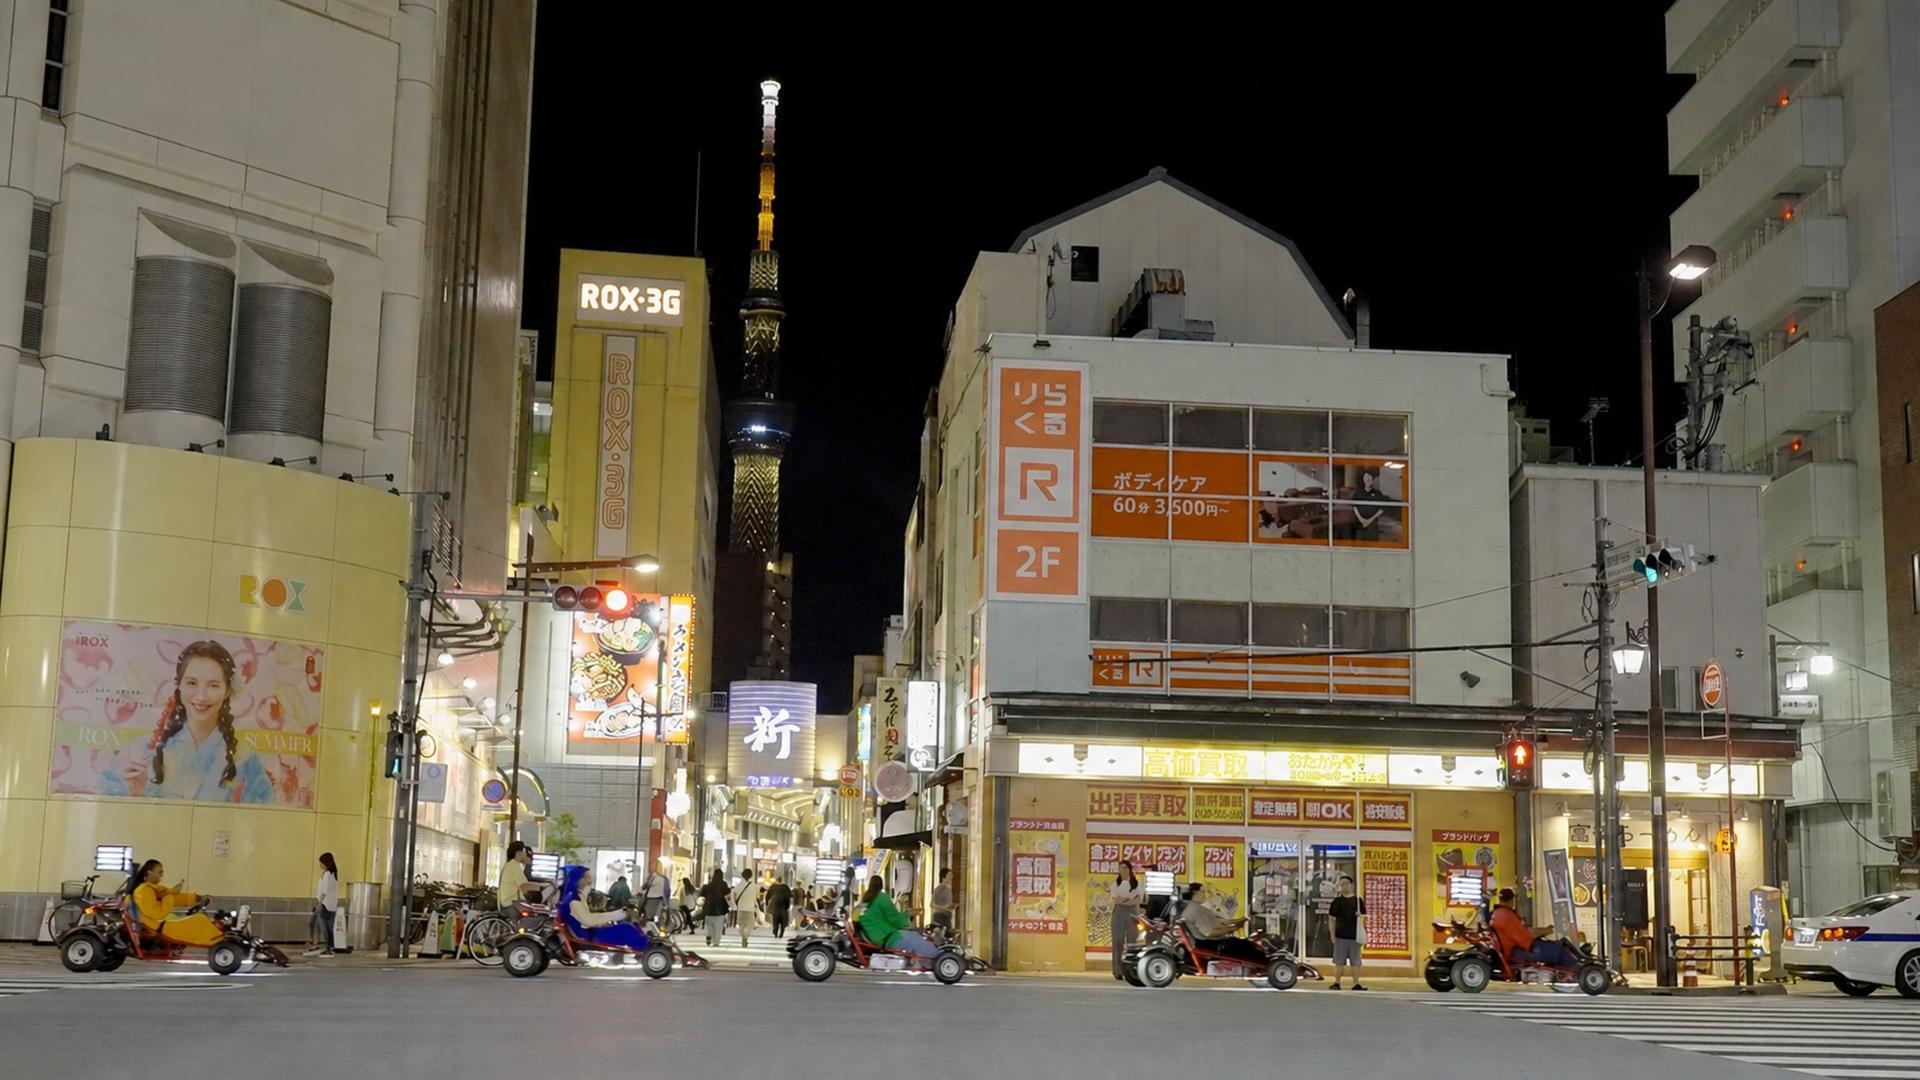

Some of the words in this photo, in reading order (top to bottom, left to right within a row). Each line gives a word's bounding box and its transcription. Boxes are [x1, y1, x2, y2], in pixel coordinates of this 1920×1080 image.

[1113, 472, 1207, 494] ボディケア
[1112, 497, 1149, 515] 60分
[1015, 545, 1061, 578] 2F
[238, 573, 310, 613] ROX
[78, 726, 121, 747] ROX
[244, 735, 312, 753] SUMMER
[744, 706, 800, 759] 新
[1145, 751, 1248, 779] 高価買取
[1090, 791, 1187, 817] 出張買取
